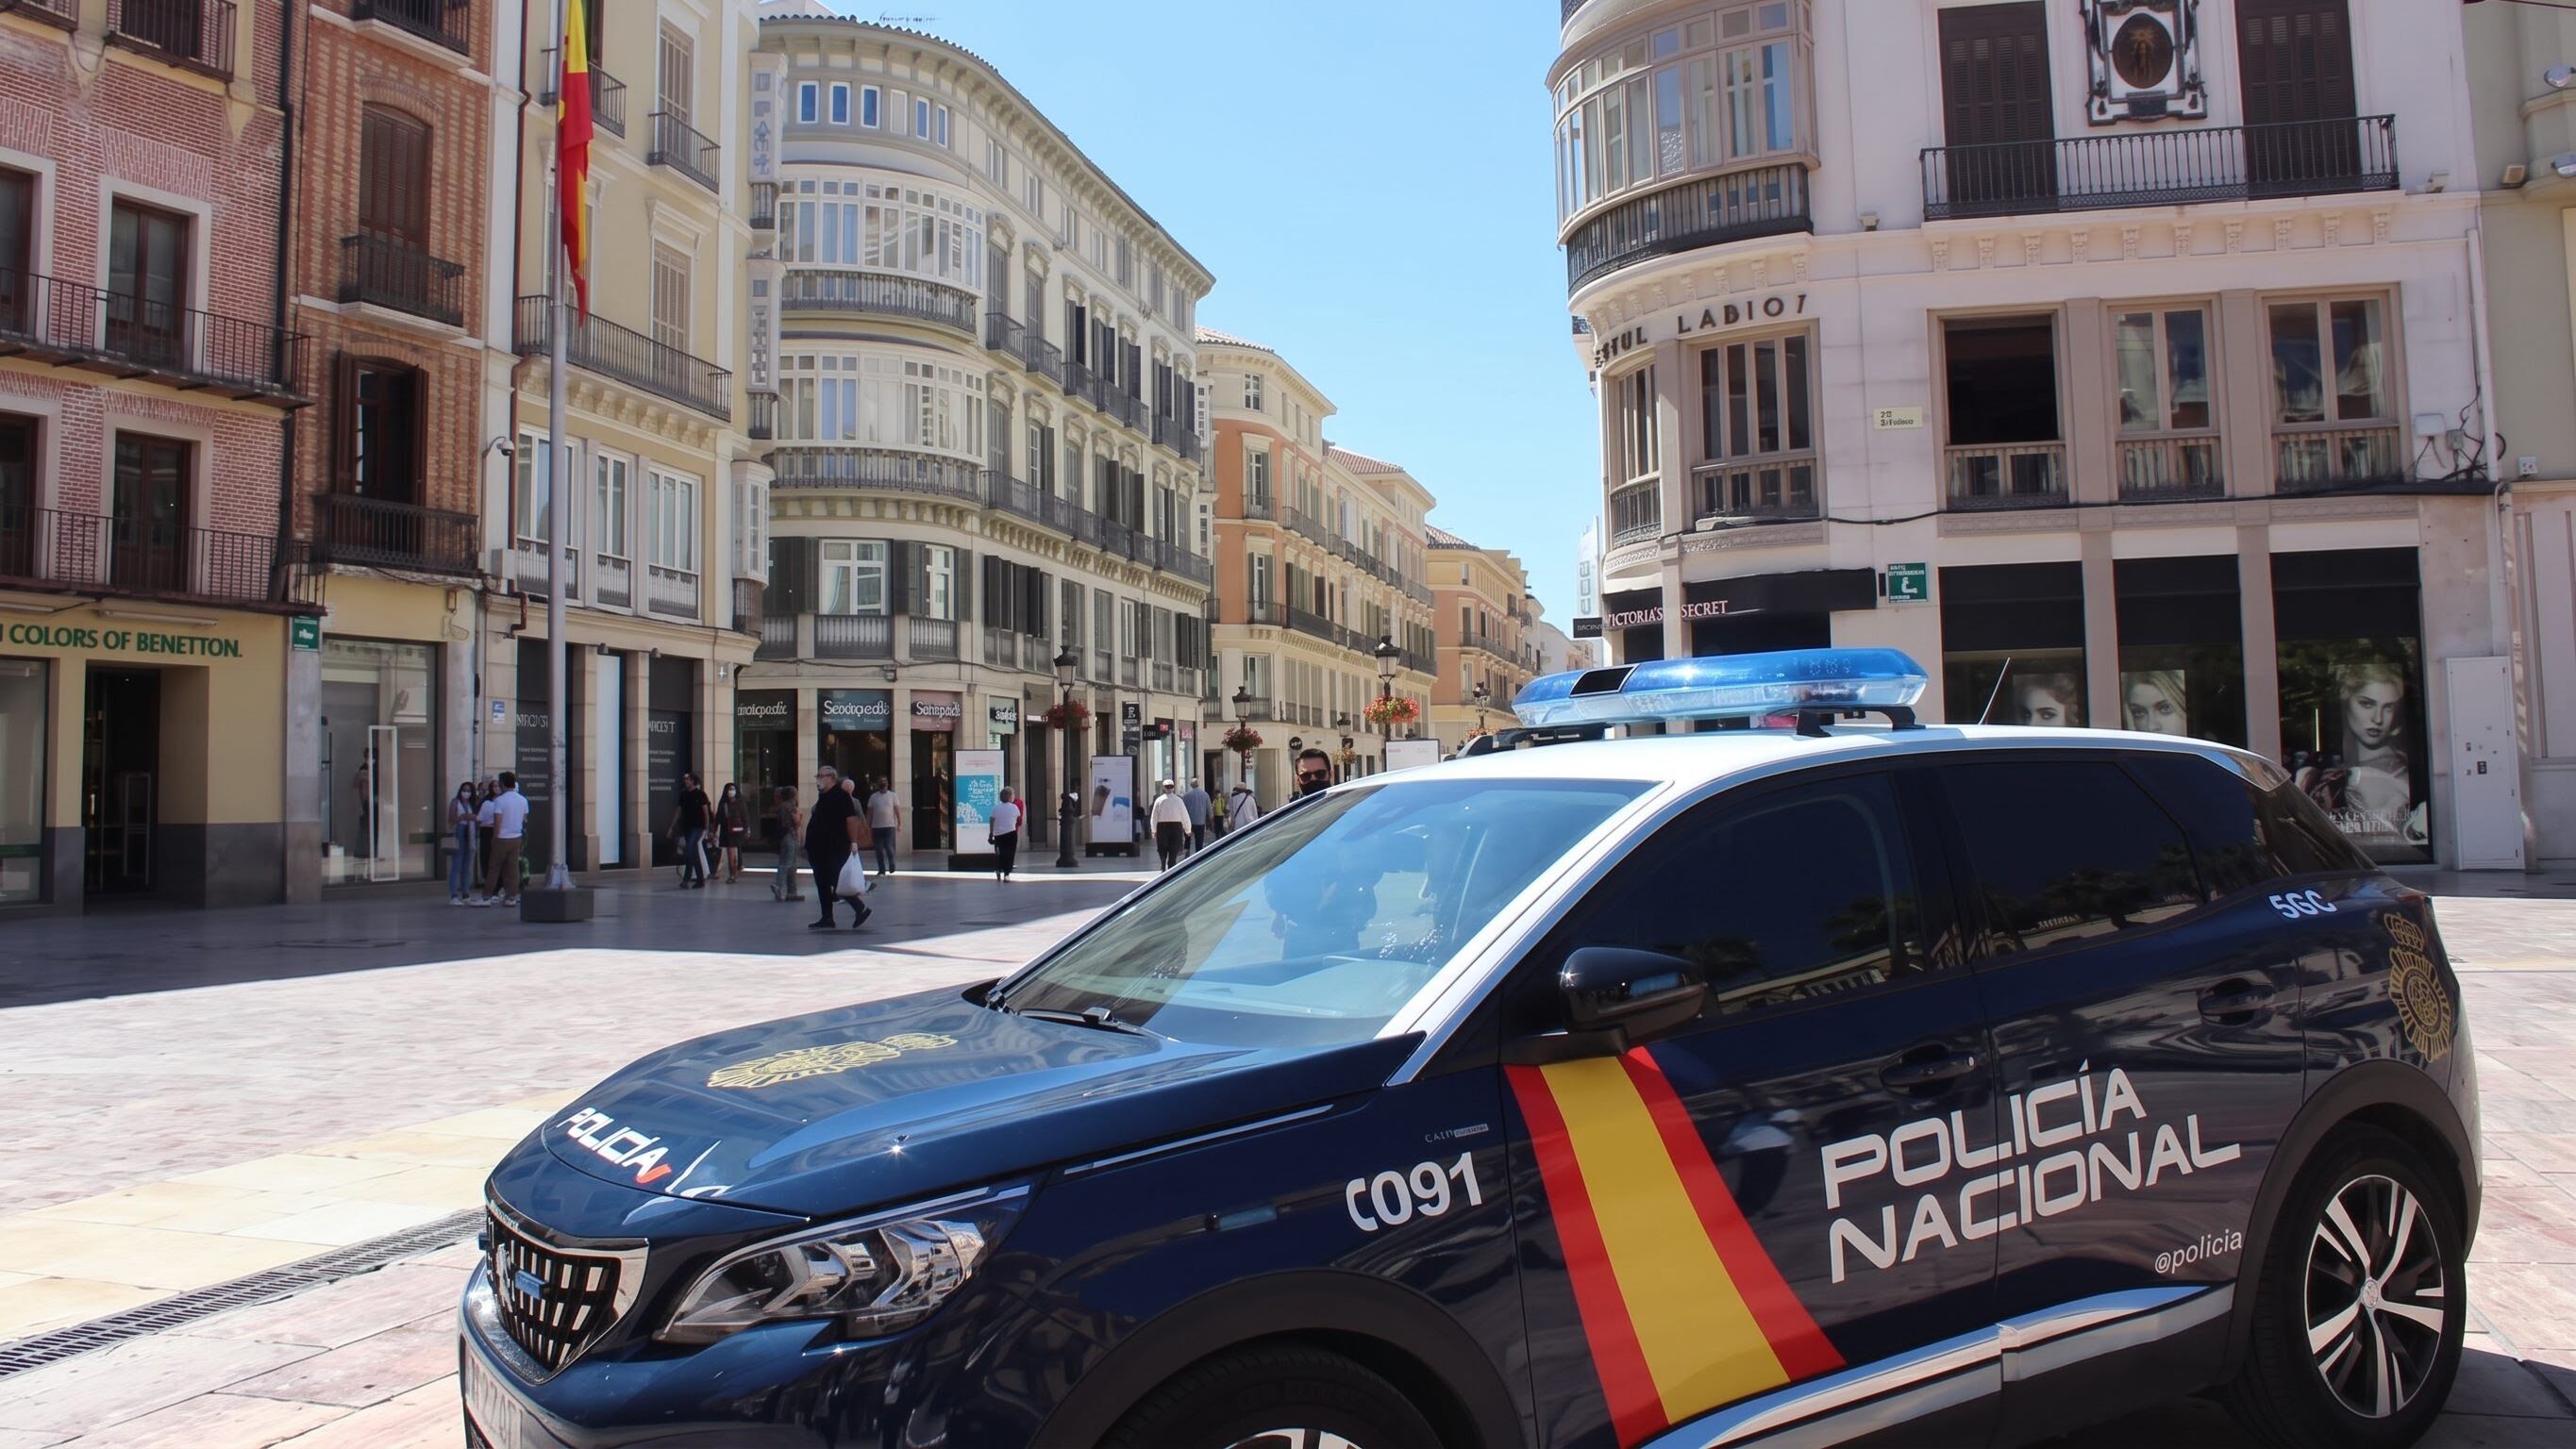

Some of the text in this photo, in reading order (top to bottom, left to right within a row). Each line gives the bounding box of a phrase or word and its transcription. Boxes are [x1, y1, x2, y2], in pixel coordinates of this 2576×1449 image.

[1681, 600, 1728, 618] SECRET
[9, 624, 99, 648] COLORS
[103, 629, 131, 650] OF
[2268, 890, 2337, 919] 5GC
[1821, 1059, 2147, 1209] POLICÍA
[1830, 1114, 2241, 1283] NACIONAL
[2155, 1228, 2242, 1274] @policia
